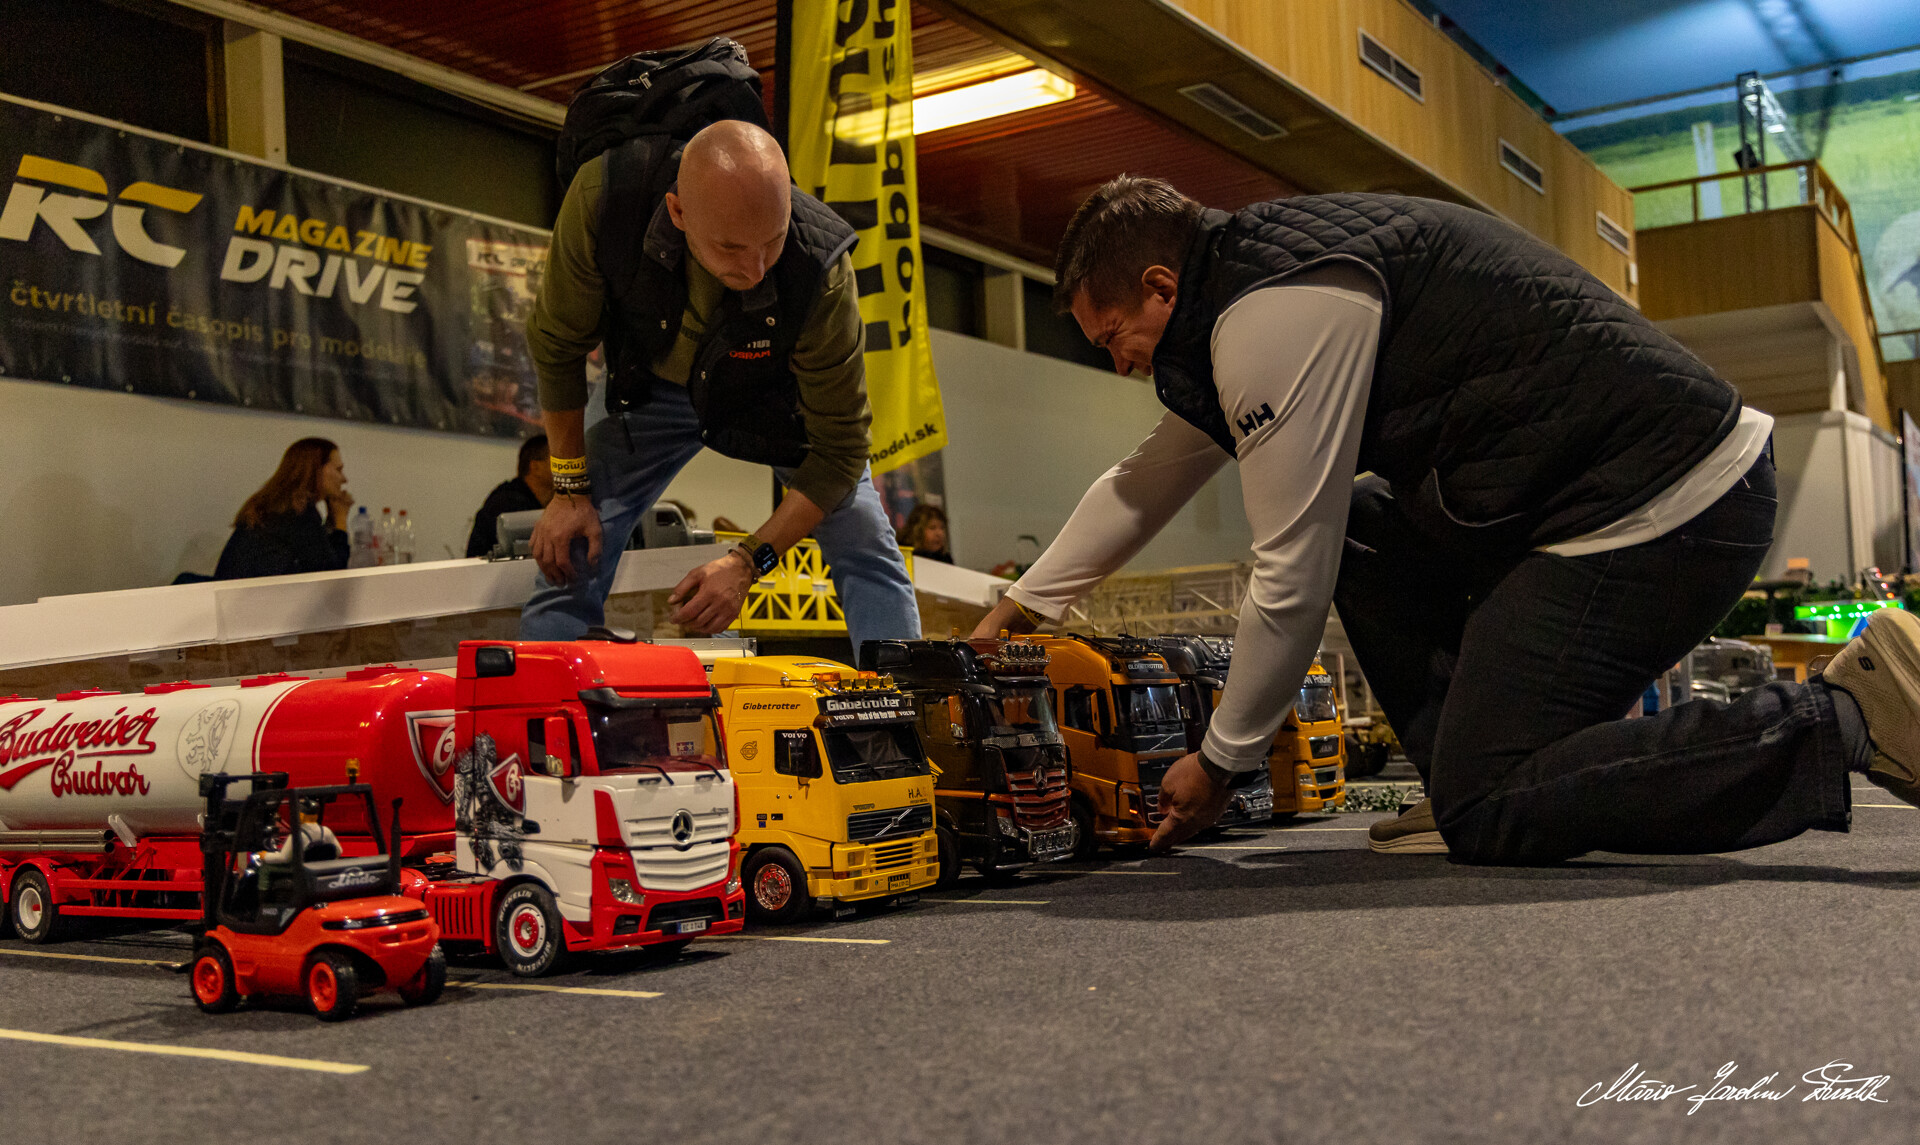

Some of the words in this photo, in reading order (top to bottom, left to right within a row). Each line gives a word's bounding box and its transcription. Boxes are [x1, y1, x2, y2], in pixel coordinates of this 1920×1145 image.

[0, 154, 204, 269] RC
[234, 205, 432, 269] MAGAZINE
[220, 236, 429, 314] DRIVE
[10, 279, 157, 326] čtvrtletní
[272, 328, 312, 350] pro
[729, 350, 771, 359] OSRAM
[1236, 402, 1275, 437] HH
[742, 702, 801, 711] Globetrotter
[826, 696, 900, 712] Globetrotter
[782, 732, 808, 740] VOLVO
[51, 750, 151, 797] Budvar
[328, 872, 380, 889] Linde
